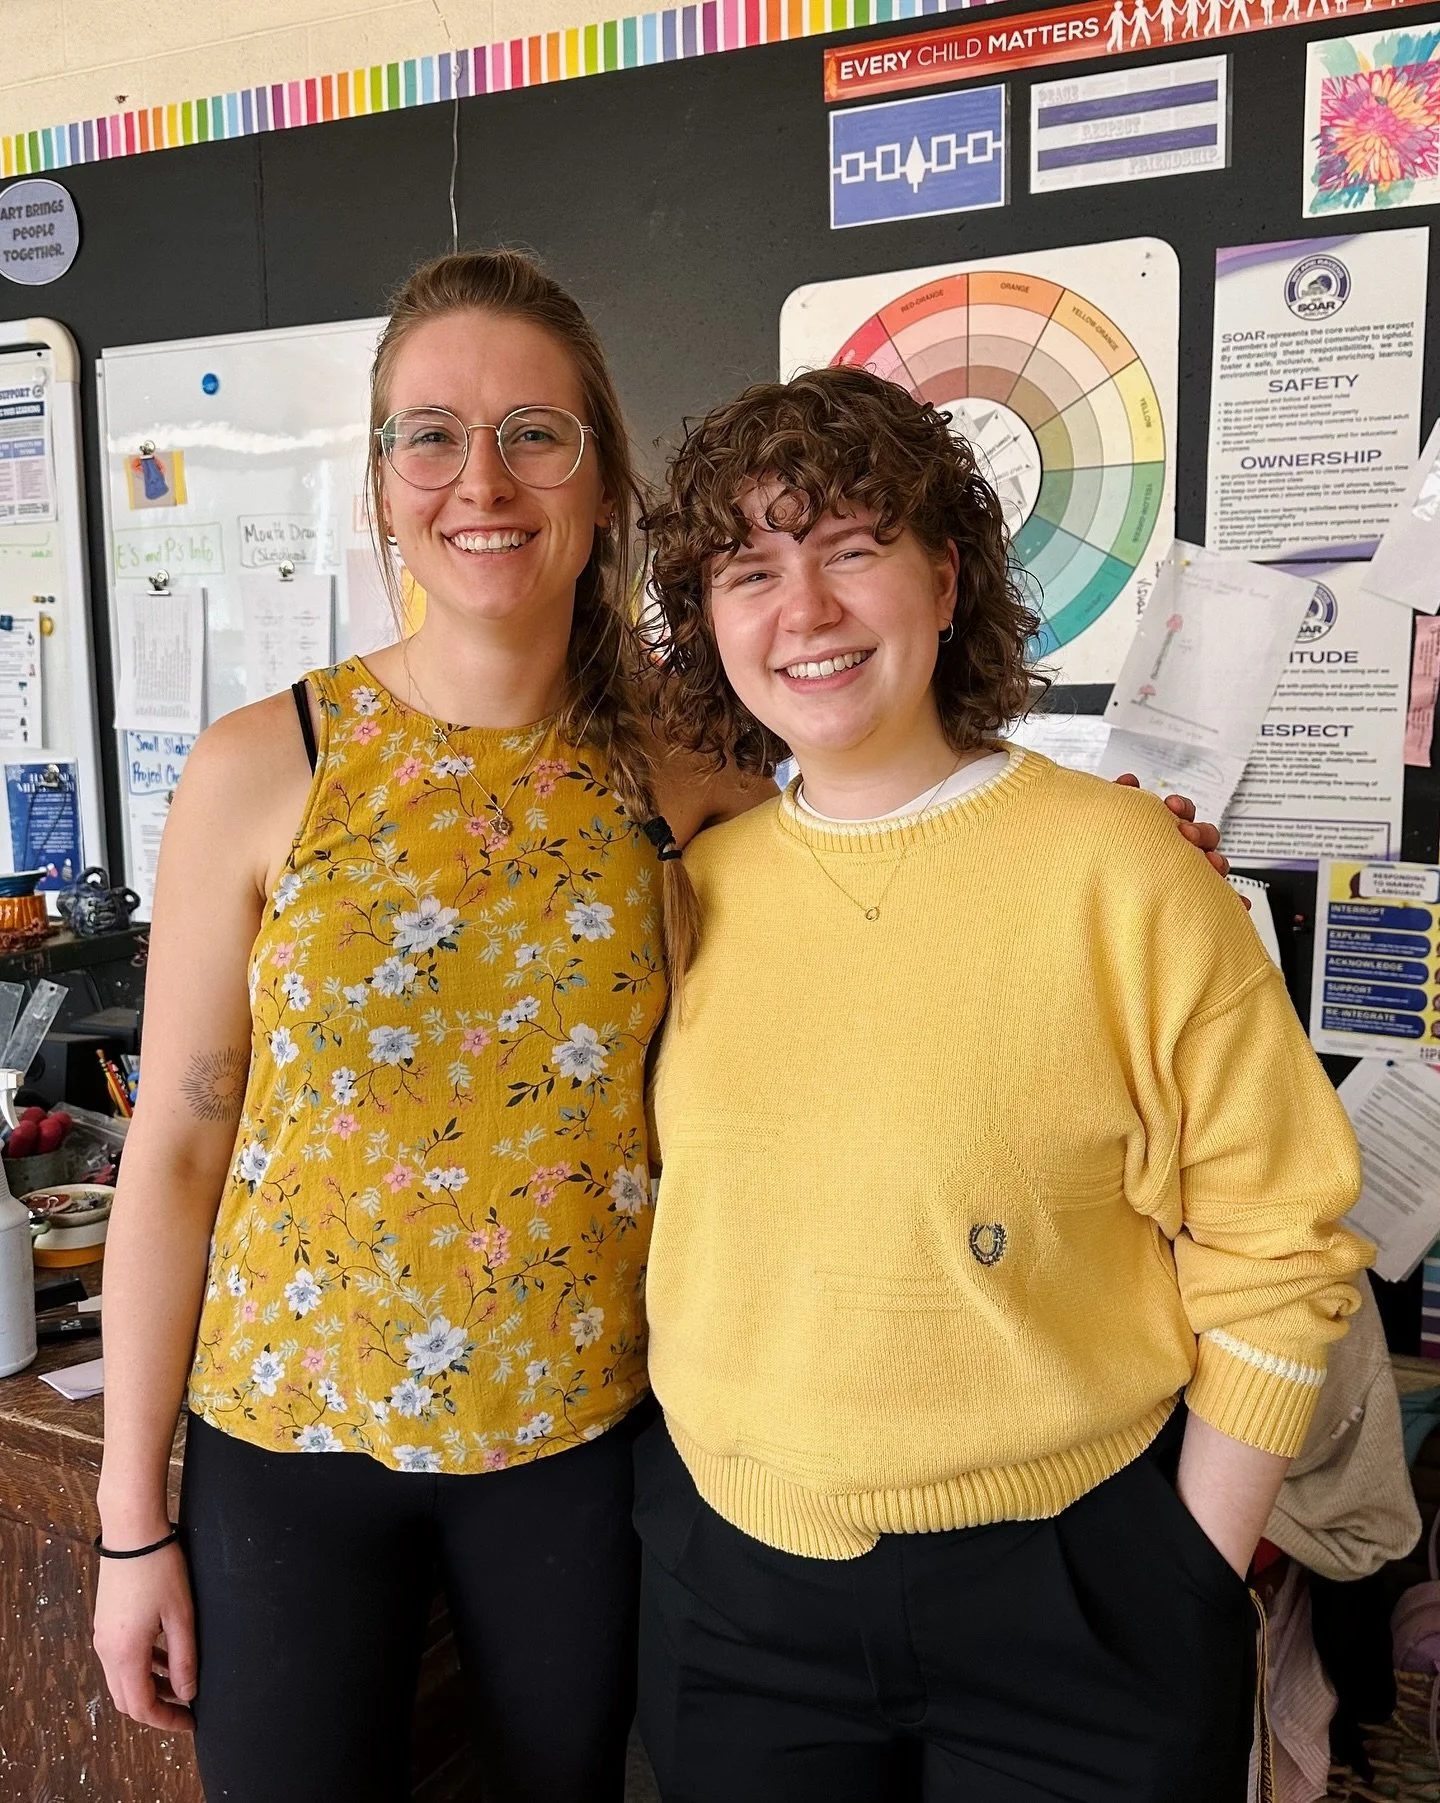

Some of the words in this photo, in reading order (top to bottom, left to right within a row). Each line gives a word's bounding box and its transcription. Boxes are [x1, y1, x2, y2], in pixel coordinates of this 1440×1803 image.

[840, 50, 912, 80] EVERY
[917, 38, 982, 66] CHILD
[987, 17, 1099, 54] MATTERS
[1081, 116, 1142, 141] RESPECT
[1000, 281, 1029, 293] ORANGE
[1221, 330, 1266, 343] SOAR
[1268, 374, 1359, 393] SAFETY
[1240, 449, 1382, 470] OWNERSHIP
[1299, 625, 1322, 634] AR
[1289, 650, 1359, 664] ITUDE
[1260, 724, 1354, 738] ESPECT
[1331, 904, 1385, 915] INTERRUPT
[1329, 931, 1371, 941] EXPLAIN
[1328, 957, 1404, 972] ACKNOWLEDGE
[1327, 983, 1372, 994] SUPPORT
